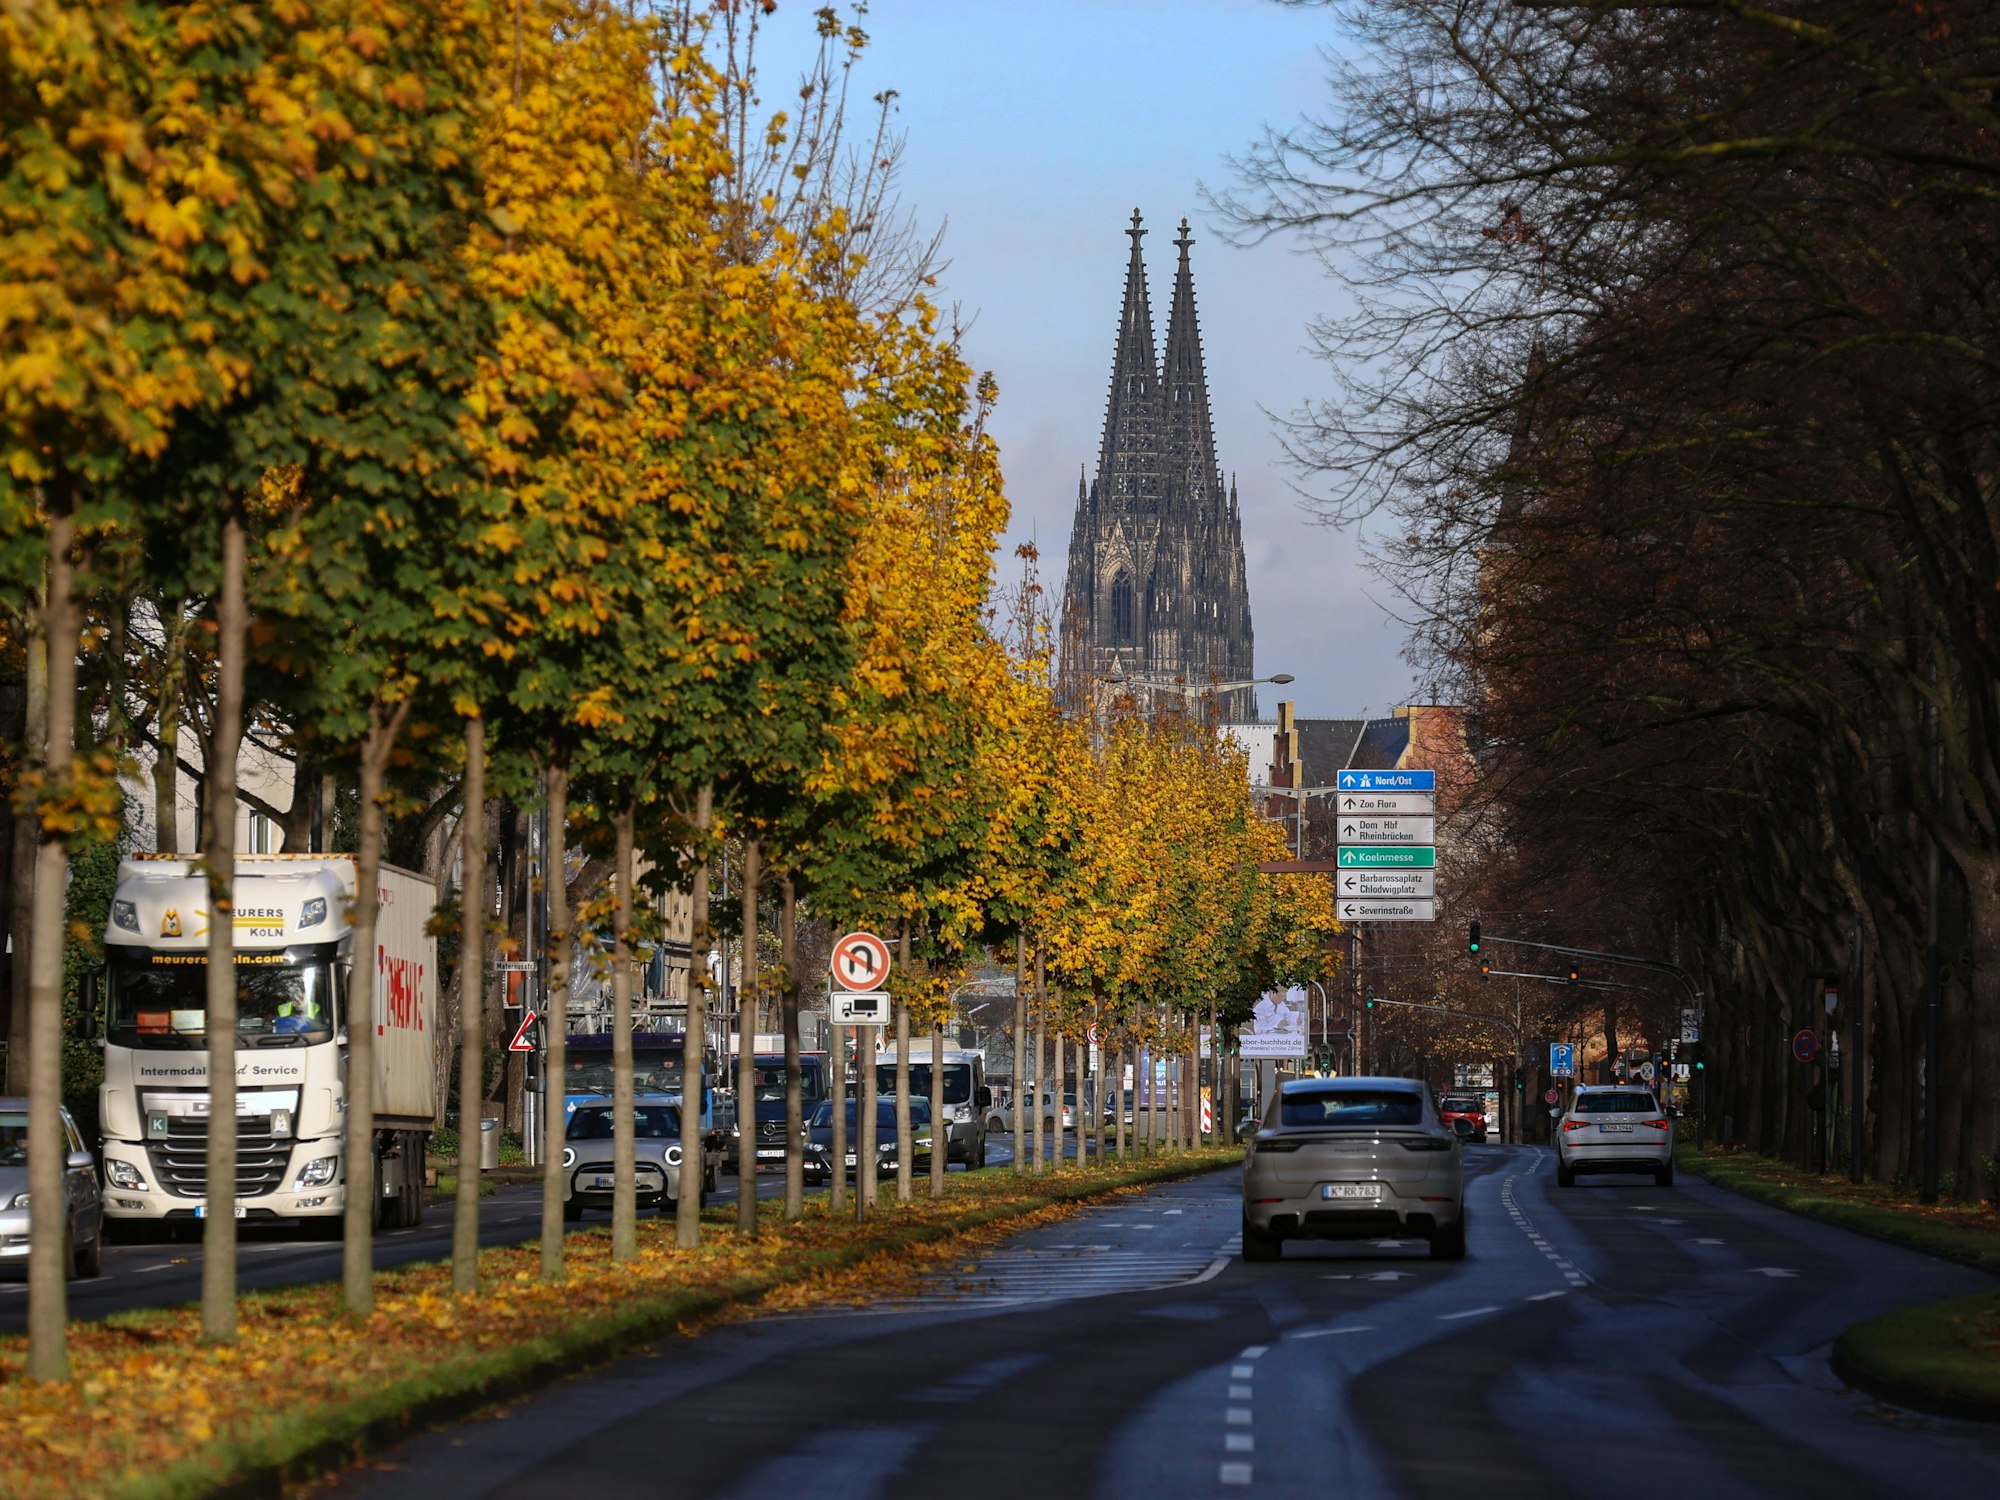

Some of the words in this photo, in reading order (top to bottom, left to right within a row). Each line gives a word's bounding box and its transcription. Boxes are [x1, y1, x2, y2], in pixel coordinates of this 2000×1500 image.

[1375, 776, 1412, 786] Nord/Ost
[1360, 800, 1374, 808] Zoo
[1378, 800, 1396, 808] Flora
[1360, 821, 1378, 829] Dom
[1384, 821, 1398, 829] Hbf
[1360, 832, 1414, 840] Rheinbrücken
[1360, 853, 1414, 862] Koelnmesse
[1360, 874, 1422, 884] Barbarossaplatz
[1360, 885, 1416, 894] Chlodwigplatz
[232, 908, 284, 916] EURERS
[1360, 906, 1414, 914] Severinstraße
[141, 1067, 206, 1076] Intermodal
[252, 1066, 298, 1074] Service
[153, 1120, 162, 1130] K
[1344, 1188, 1356, 1196] RR
[1359, 1188, 1376, 1196] 783
